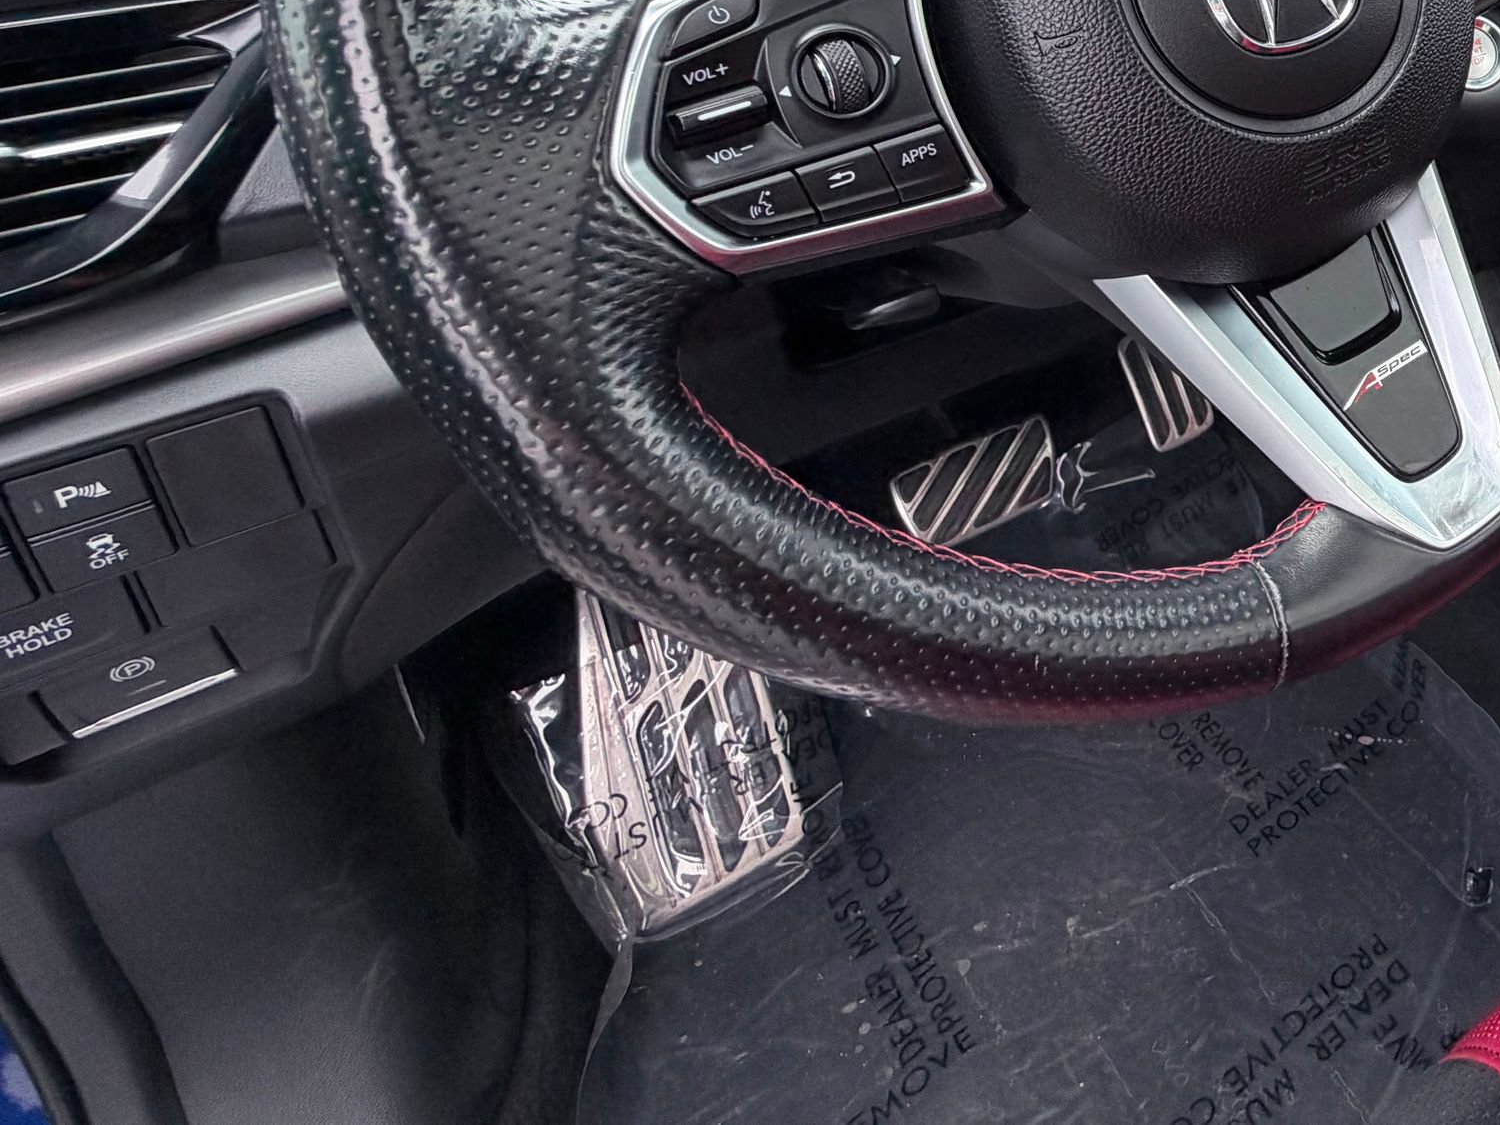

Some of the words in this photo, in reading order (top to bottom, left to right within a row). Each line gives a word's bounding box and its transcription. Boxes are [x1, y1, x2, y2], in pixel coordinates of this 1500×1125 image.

[900, 142, 937, 167] APPS
[89, 548, 130, 571] OFF
[5, 627, 74, 659] HOLD
[1156, 720, 1205, 773] OVER
[1190, 711, 1264, 792] REMOVE
[1229, 758, 1319, 836] DEALER
[1327, 697, 1388, 757] MUST
[1245, 744, 1385, 857] PROTECTIVE
[1386, 658, 1426, 738] COVER
[827, 888, 880, 962] MUST
[876, 887, 965, 1036] PROTECTIVE
[1222, 932, 1388, 1097] PROTECTIVE
[1308, 959, 1410, 1062] DEALER
